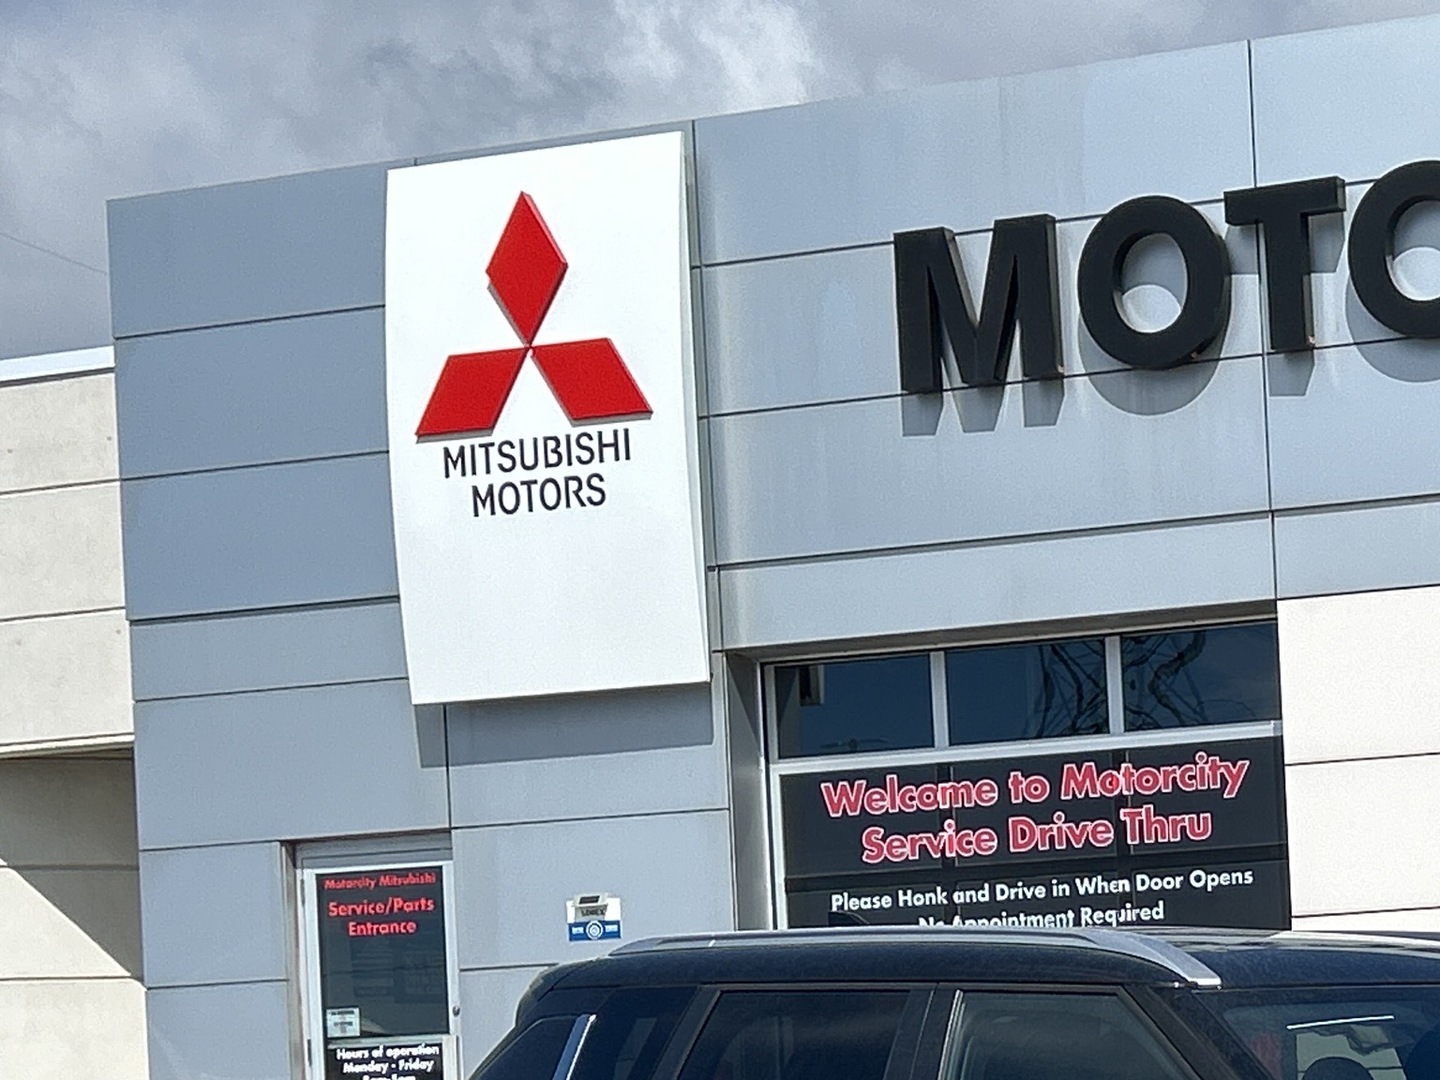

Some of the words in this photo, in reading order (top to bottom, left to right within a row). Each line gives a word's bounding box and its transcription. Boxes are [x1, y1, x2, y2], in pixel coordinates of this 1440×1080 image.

[443, 428, 631, 478] MITSUBISHI
[472, 473, 606, 517] MOTORS
[821, 774, 998, 818] Welcome
[1009, 771, 1049, 803] to
[1061, 751, 1250, 800] Motorcity
[862, 819, 997, 864] Service
[1009, 811, 1114, 854] Drive
[1120, 805, 1212, 845] Thru
[329, 897, 434, 917] Service/Parts
[831, 891, 892, 913] Please
[898, 886, 948, 907] Honk
[952, 882, 990, 905] and
[995, 879, 1046, 901] Drive
[1052, 877, 1070, 897] in
[1075, 873, 1130, 895] When
[1136, 871, 1183, 893] Door
[1189, 868, 1254, 890] Opens
[348, 922, 417, 936] Entrance
[1080, 900, 1165, 927] Required
[336, 1048, 369, 1060] Hours
[371, 1045, 384, 1058] of
[386, 1043, 439, 1059] operation
[343, 1060, 388, 1074] Monday
[398, 1058, 435, 1072] Friday
